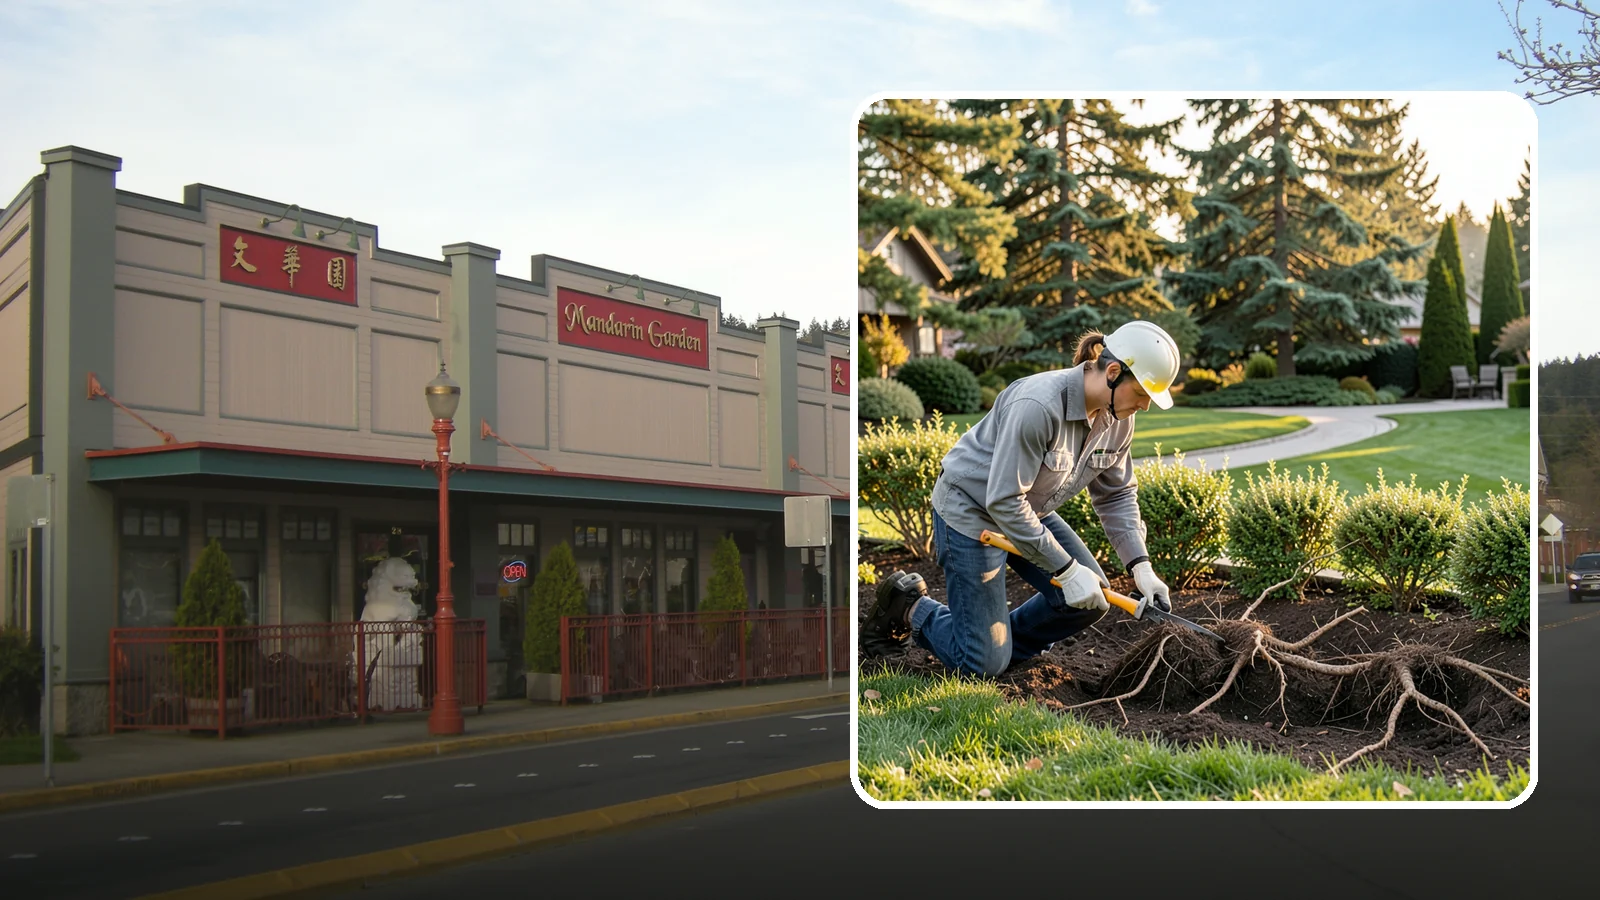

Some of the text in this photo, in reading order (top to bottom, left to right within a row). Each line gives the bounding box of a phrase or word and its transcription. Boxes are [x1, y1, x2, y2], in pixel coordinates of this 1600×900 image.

[230, 235, 346, 291] 文華園
[564, 302, 702, 352] Mandarin Garden
[834, 362, 846, 386] 文
[503, 565, 527, 578] OPEN
